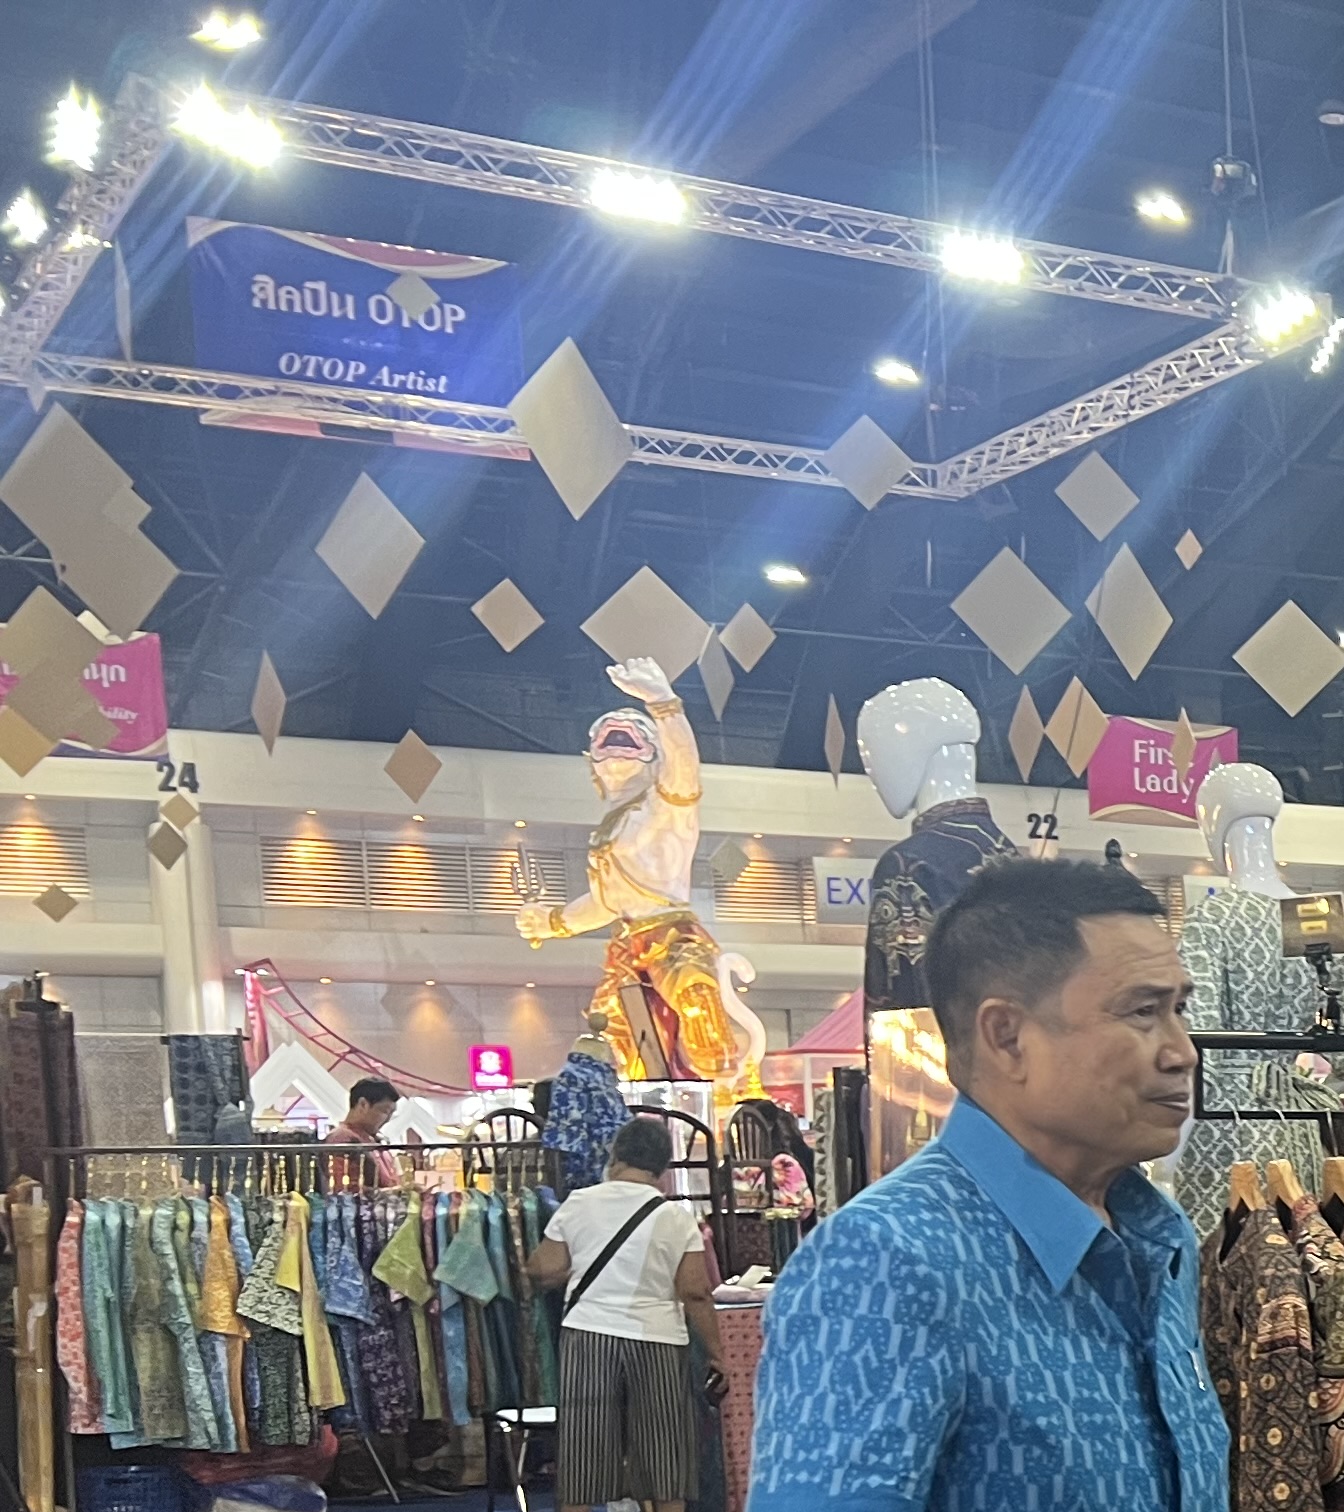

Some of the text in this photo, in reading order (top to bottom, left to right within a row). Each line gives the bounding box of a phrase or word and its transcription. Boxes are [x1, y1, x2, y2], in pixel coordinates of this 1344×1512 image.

[278, 352, 449, 394] OTOP Artist
[1133, 738, 1195, 768] Firs
[156, 761, 200, 794] 24
[1133, 767, 1195, 804] Lady
[1027, 813, 1060, 840] 22
